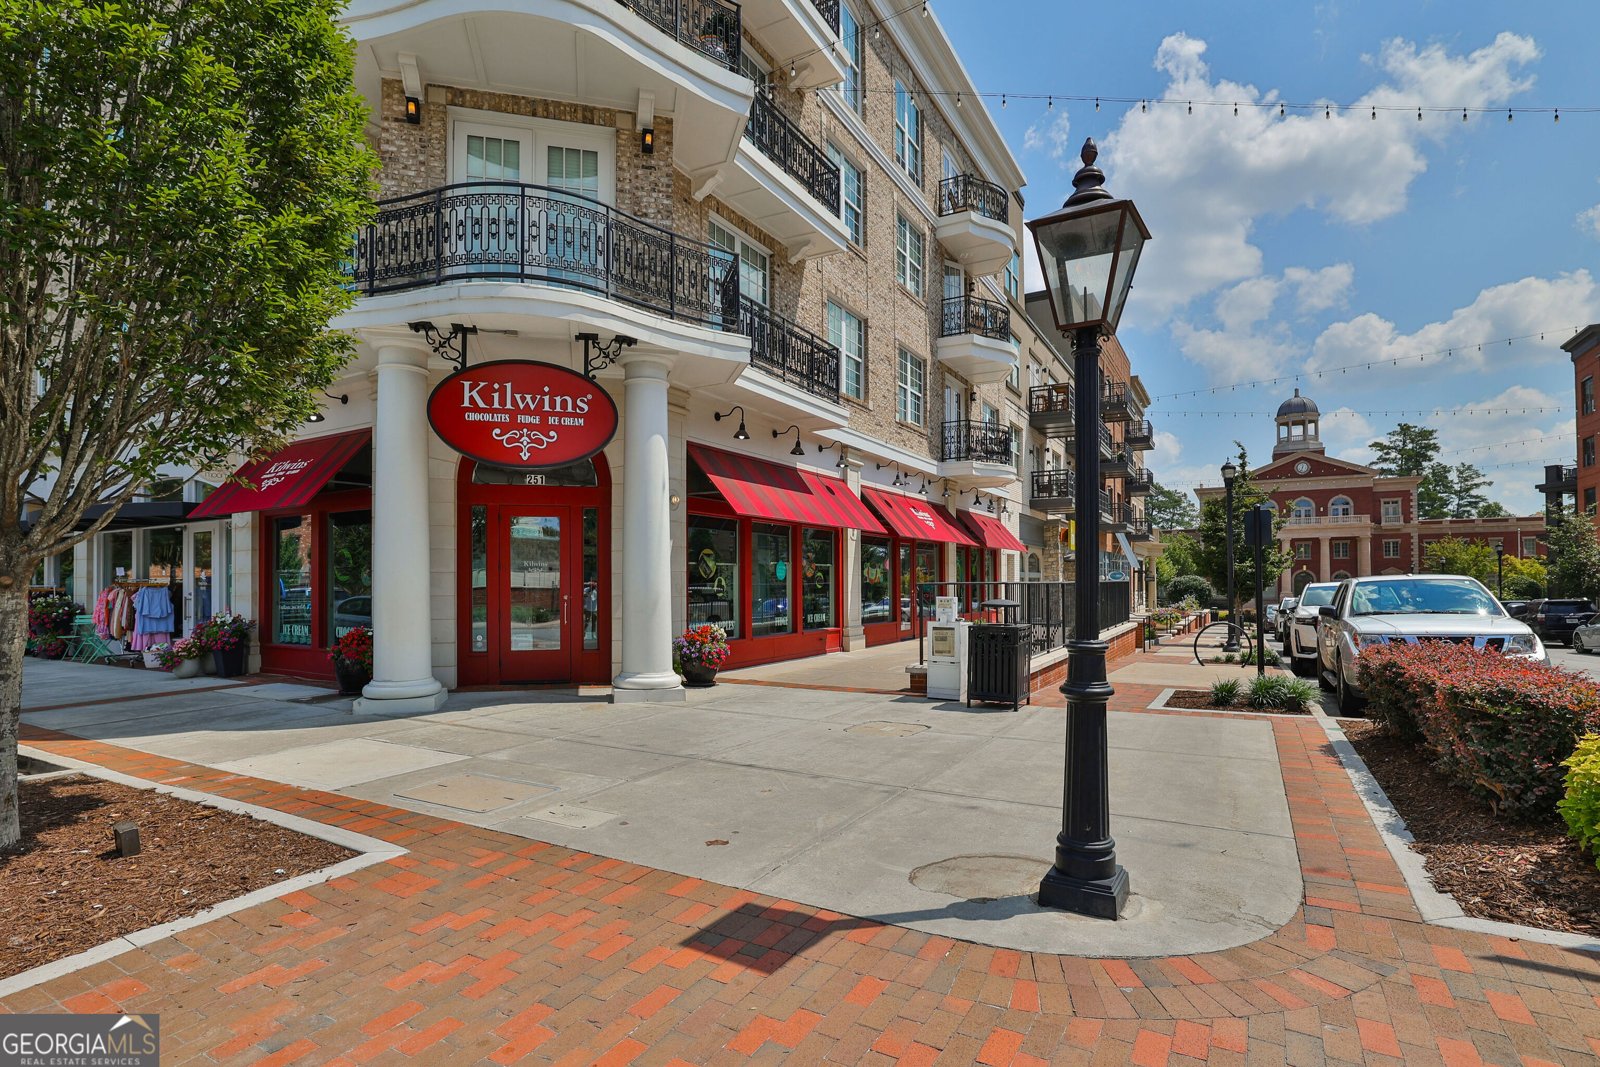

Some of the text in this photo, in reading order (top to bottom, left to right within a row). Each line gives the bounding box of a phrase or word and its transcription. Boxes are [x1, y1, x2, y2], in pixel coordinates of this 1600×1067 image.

[460, 381, 590, 414] Kilwins
[465, 412, 584, 426] CHOCOLATES FUDGE ICE CREAM
[527, 475, 545, 485] 251
[283, 624, 309, 636] ICE CREAM
